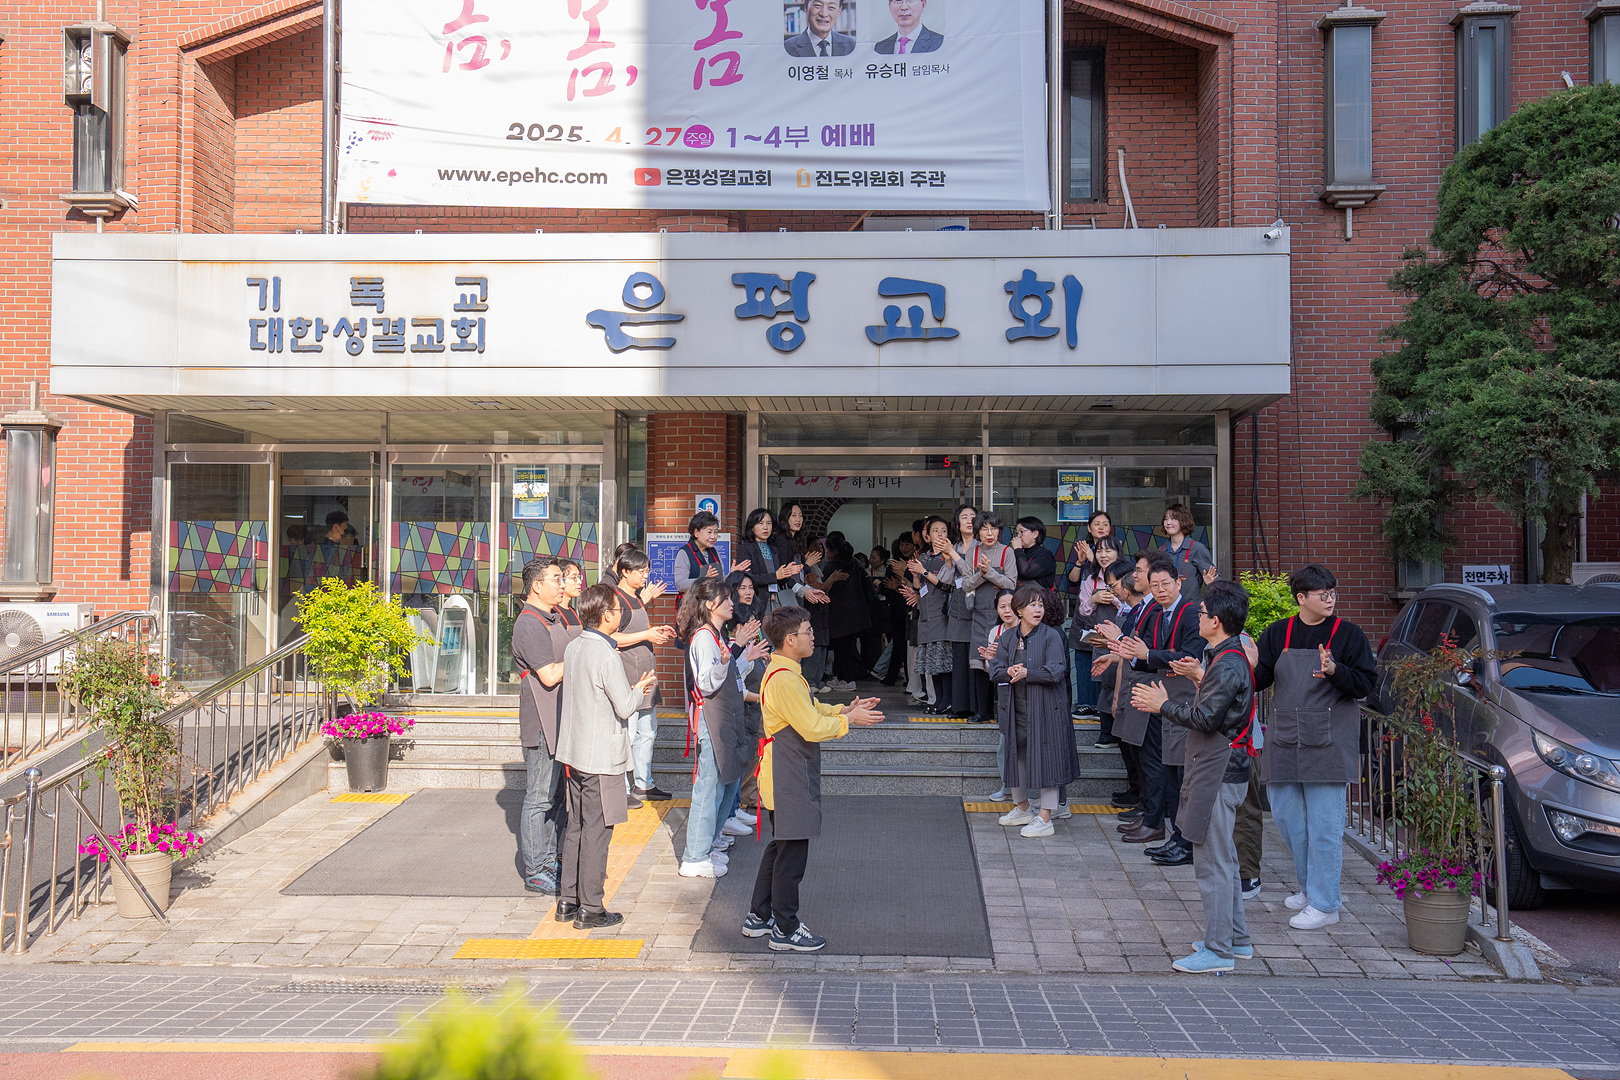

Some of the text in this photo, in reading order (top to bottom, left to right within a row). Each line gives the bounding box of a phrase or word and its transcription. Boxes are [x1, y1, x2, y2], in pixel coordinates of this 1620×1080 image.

[788, 62, 950, 81] 이영철 목사 유승대 담임목사
[506, 122, 591, 143] 2025.
[726, 125, 810, 149] 1~4부
[820, 122, 875, 147] 예배
[437, 167, 608, 186] www.epehc.com
[666, 168, 772, 187] 은평성결교회
[815, 170, 946, 188] 전도위원회 주관
[248, 316, 487, 357] 대한성결교회
[1464, 571, 1509, 584] 전면주차
